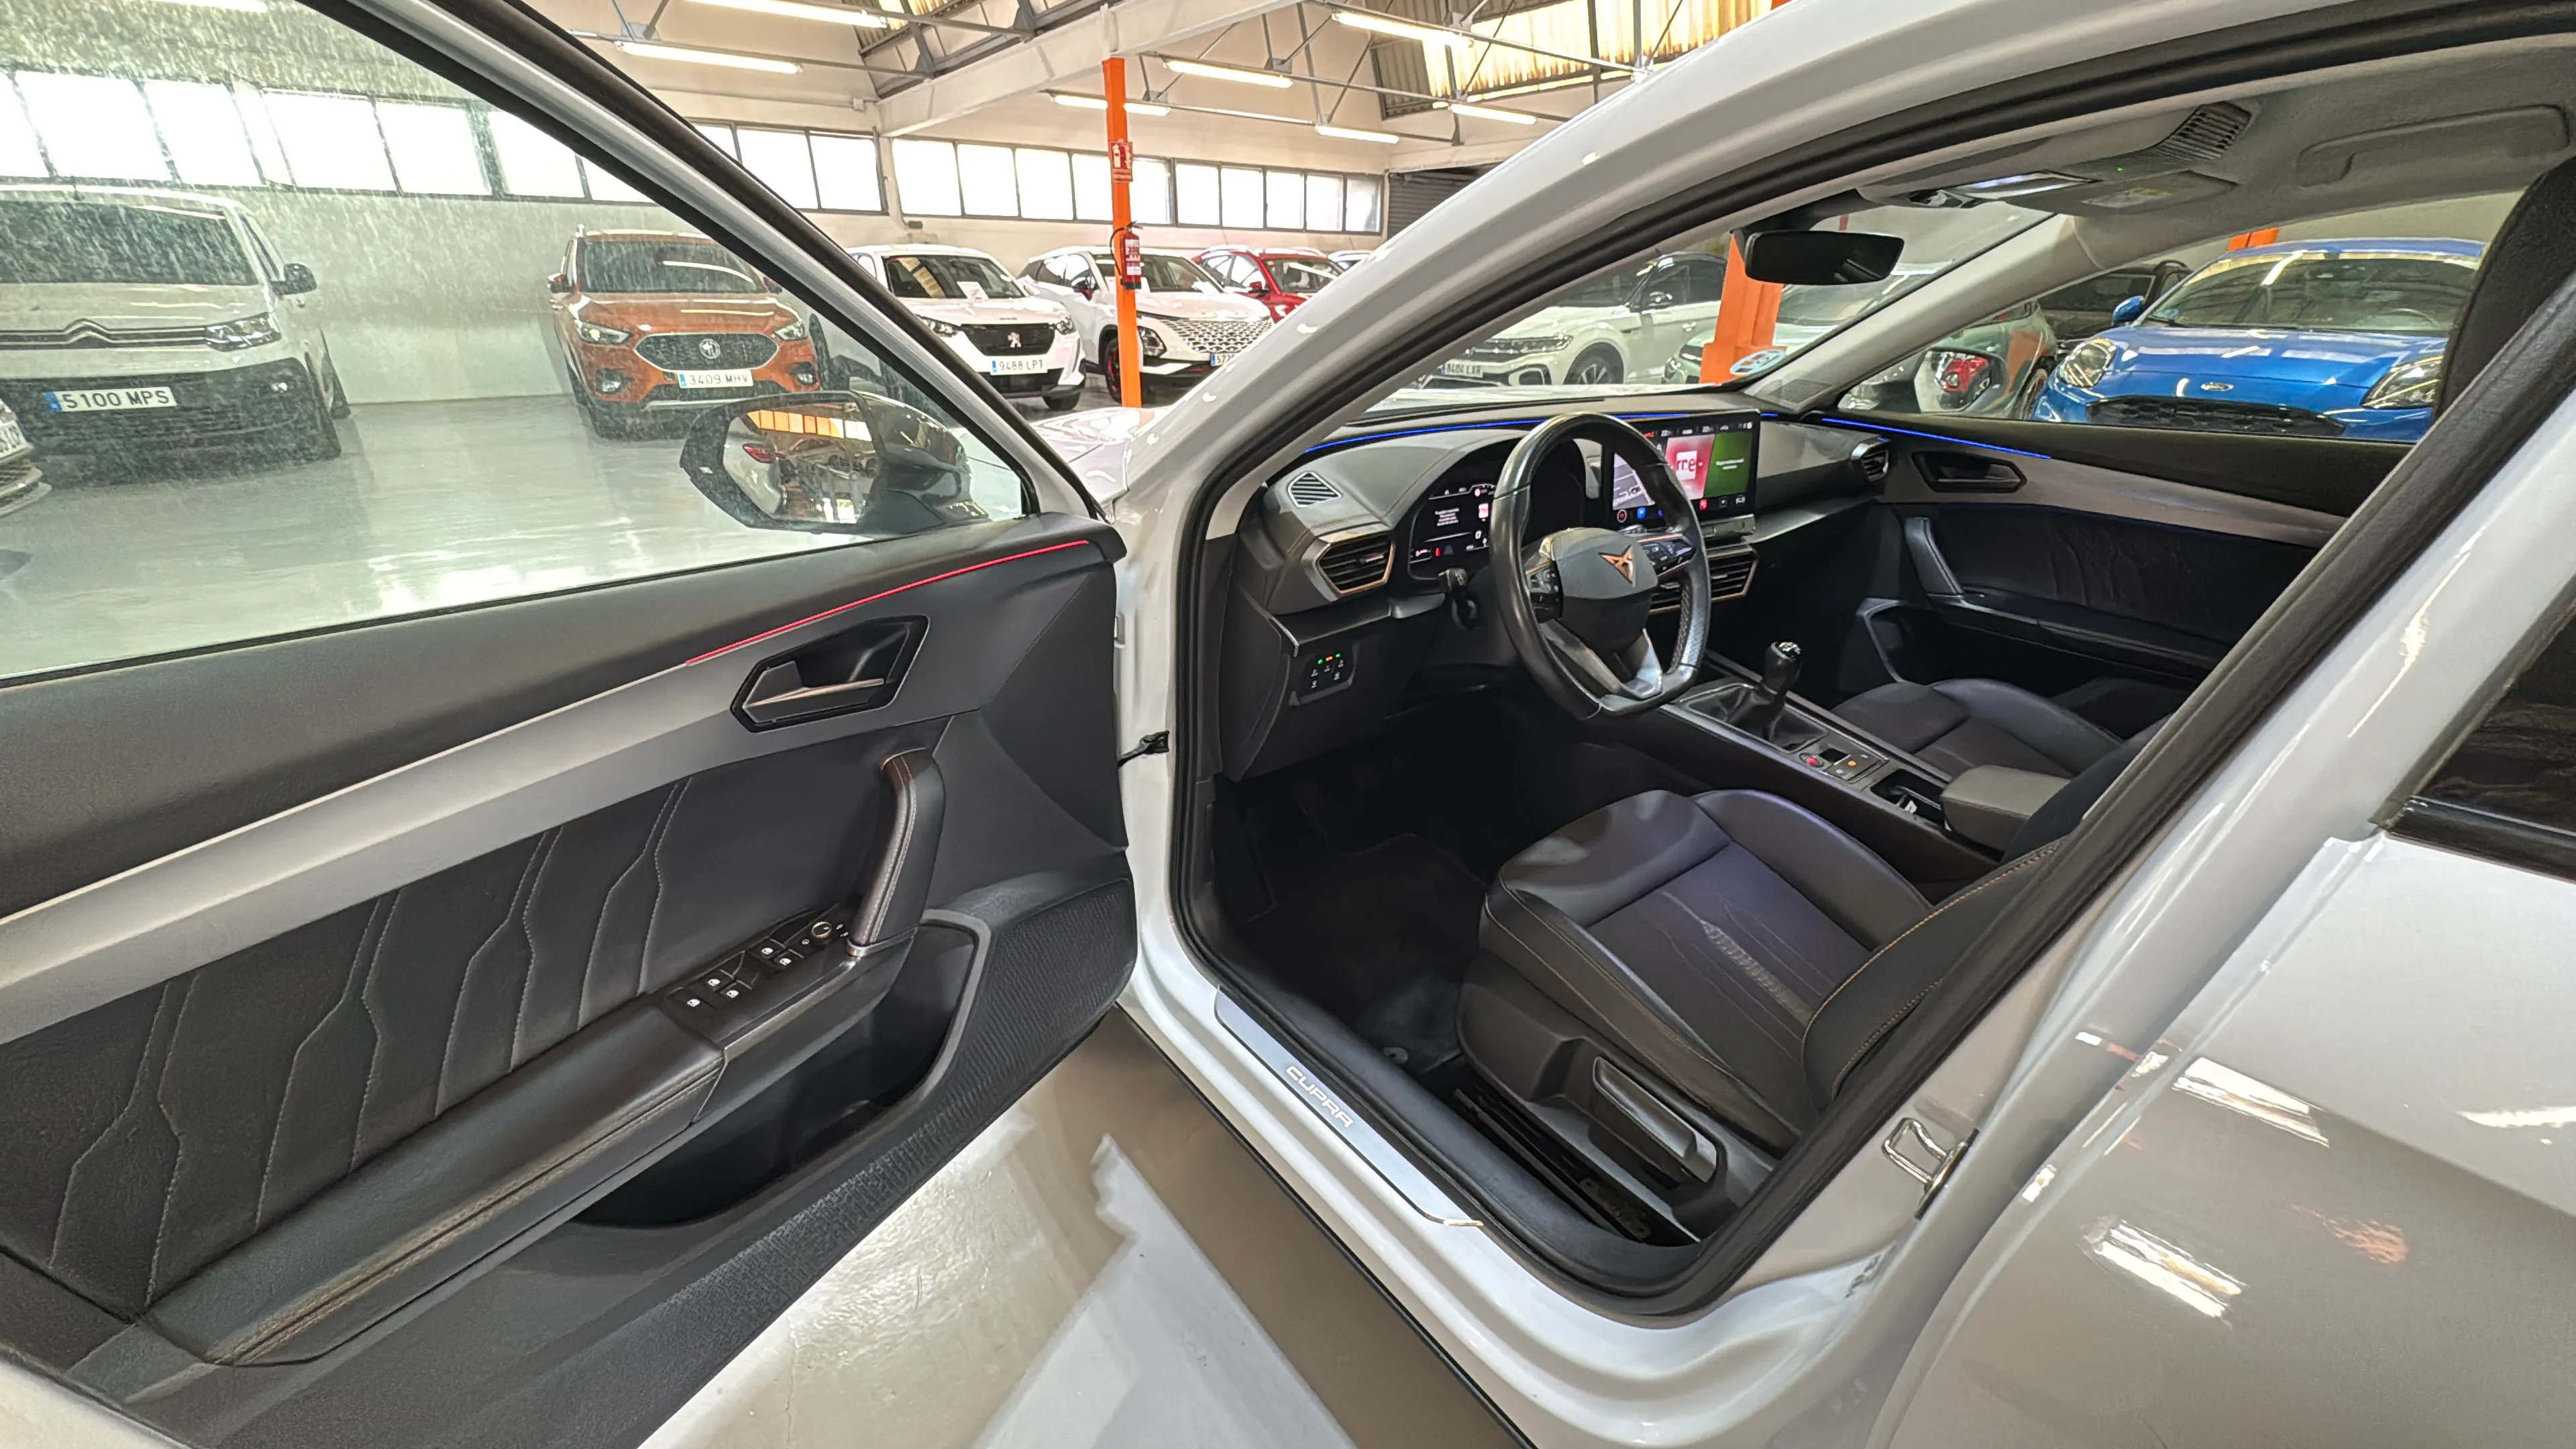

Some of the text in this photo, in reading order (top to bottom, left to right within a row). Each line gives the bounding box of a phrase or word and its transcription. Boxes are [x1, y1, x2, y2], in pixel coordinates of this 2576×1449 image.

[689, 374, 748, 385] 3409 MHV
[62, 390, 170, 409] 5100 MPS
[1286, 1065, 1354, 1128] CUPRA
